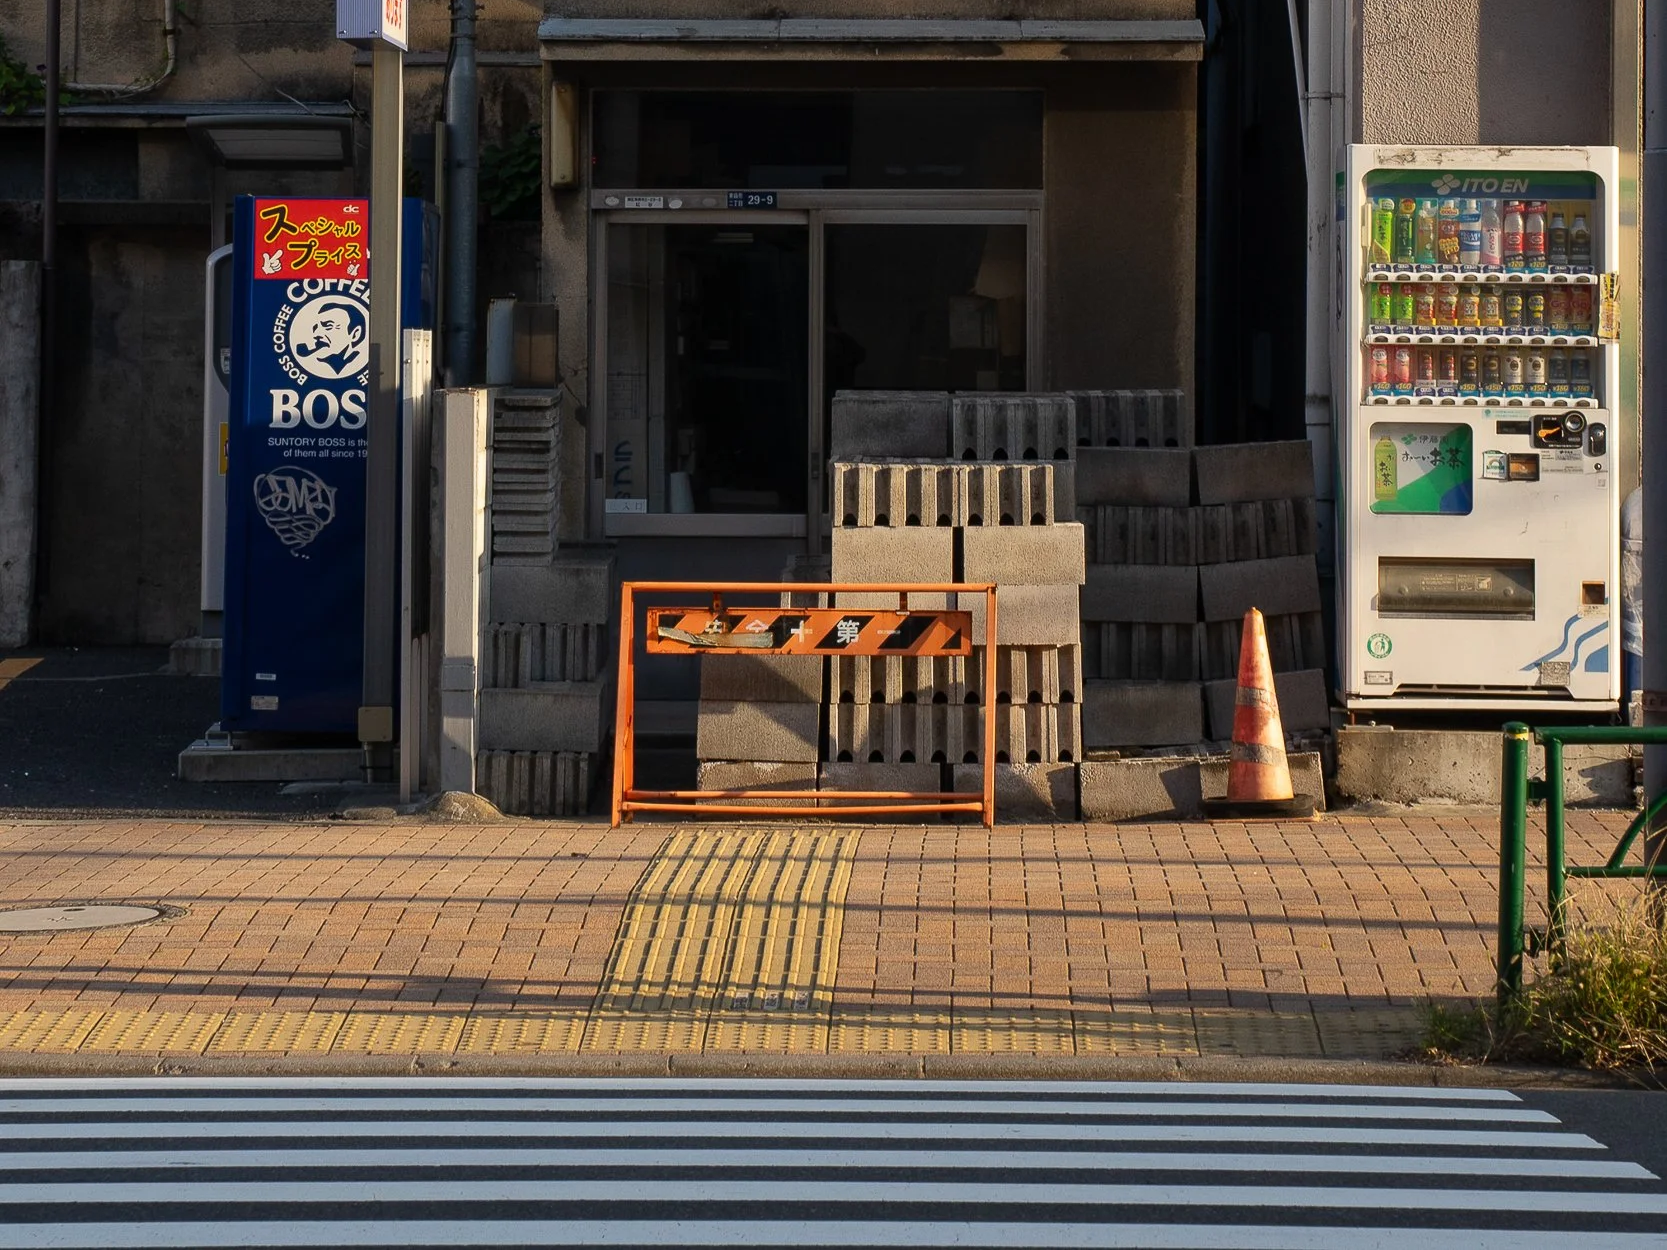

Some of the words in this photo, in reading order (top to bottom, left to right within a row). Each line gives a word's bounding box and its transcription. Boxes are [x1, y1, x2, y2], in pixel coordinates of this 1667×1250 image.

[1461, 178, 1498, 193] ITO
[1500, 178, 1529, 193] EN
[343, 204, 359, 213] dc
[748, 195, 773, 205] 29-9
[260, 203, 361, 243] スペシャル
[287, 239, 361, 270] プライス
[273, 304, 294, 353] COFFEE
[278, 355, 308, 386] BOSS
[269, 388, 367, 430] BOS
[268, 437, 316, 447] SUNTORY
[318, 437, 346, 447] BOSS
[347, 437, 356, 447] is
[283, 448, 293, 458] of
[294, 448, 317, 458] them
[318, 448, 329, 458] all
[330, 448, 355, 458] since
[357, 448, 368, 458] 19
